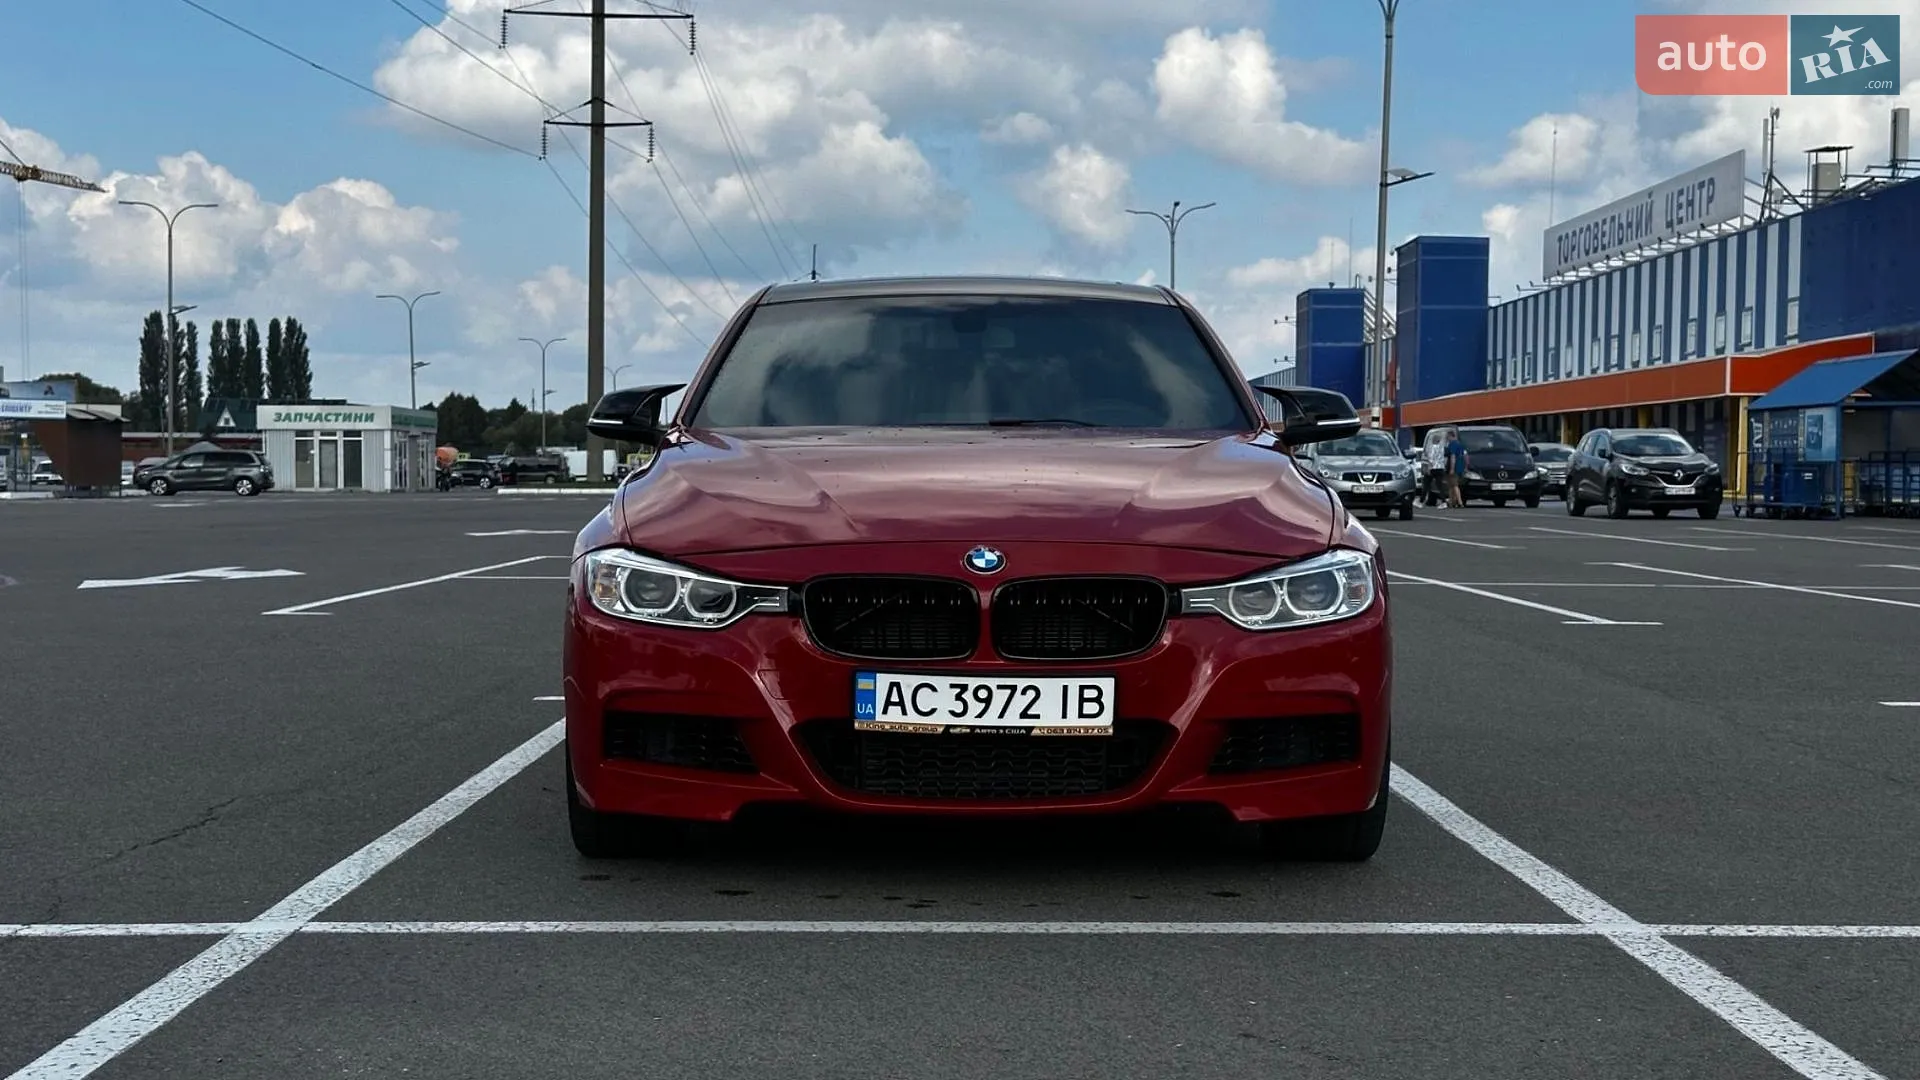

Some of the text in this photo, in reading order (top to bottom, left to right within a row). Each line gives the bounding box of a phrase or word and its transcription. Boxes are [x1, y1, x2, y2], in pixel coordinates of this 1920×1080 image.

[1556, 177, 1716, 266] ТОРГОВЕЛЬНИЙ ЦЕНТР
[273, 412, 375, 423] ЗАПЧАСТИНИ
[857, 703, 874, 715] UA
[882, 681, 1105, 720] AC 3972 IB
